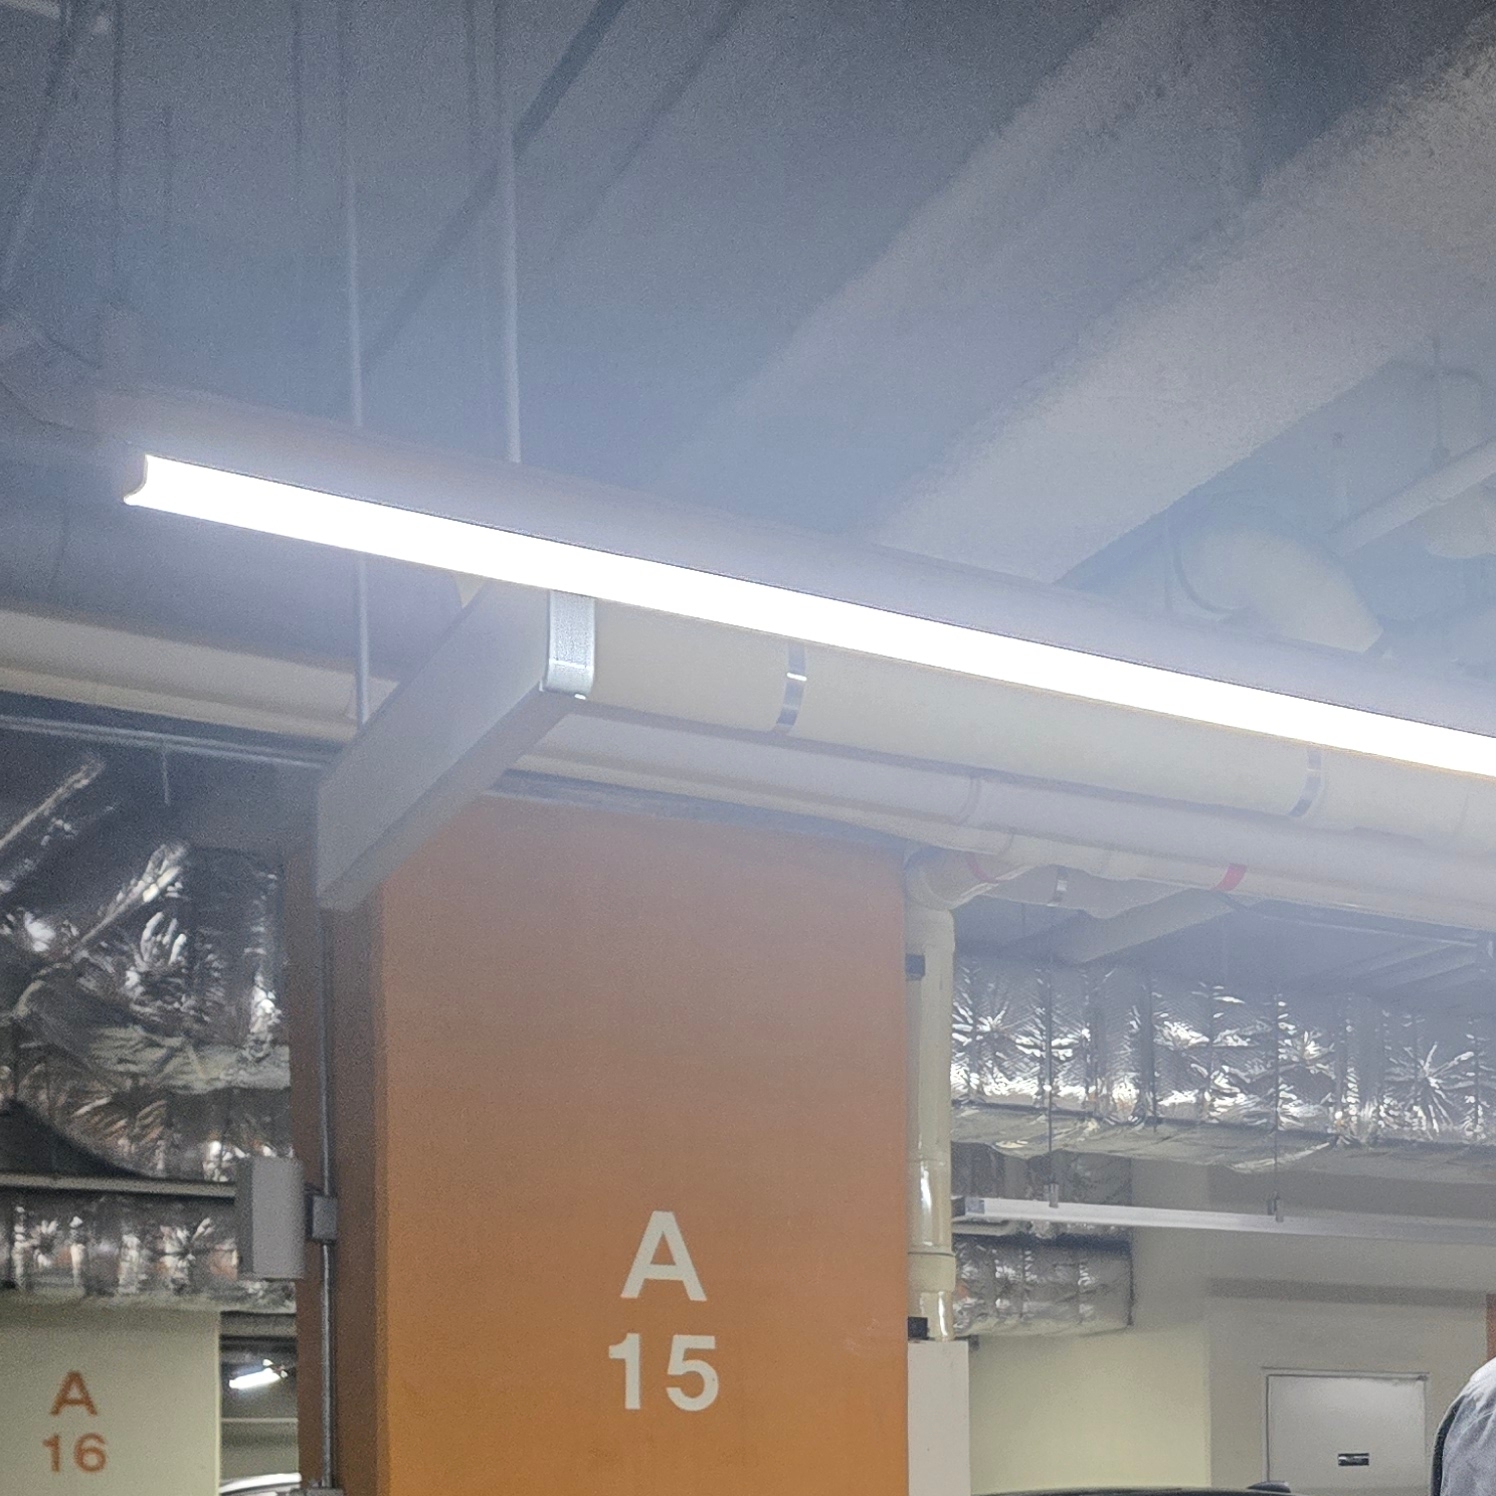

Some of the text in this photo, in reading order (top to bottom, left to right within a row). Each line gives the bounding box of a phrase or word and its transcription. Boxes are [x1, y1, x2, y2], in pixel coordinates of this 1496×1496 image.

[621, 1211, 706, 1302] A
[50, 1370, 98, 1416] A
[608, 1332, 720, 1412] 15
[42, 1433, 106, 1473] 16
